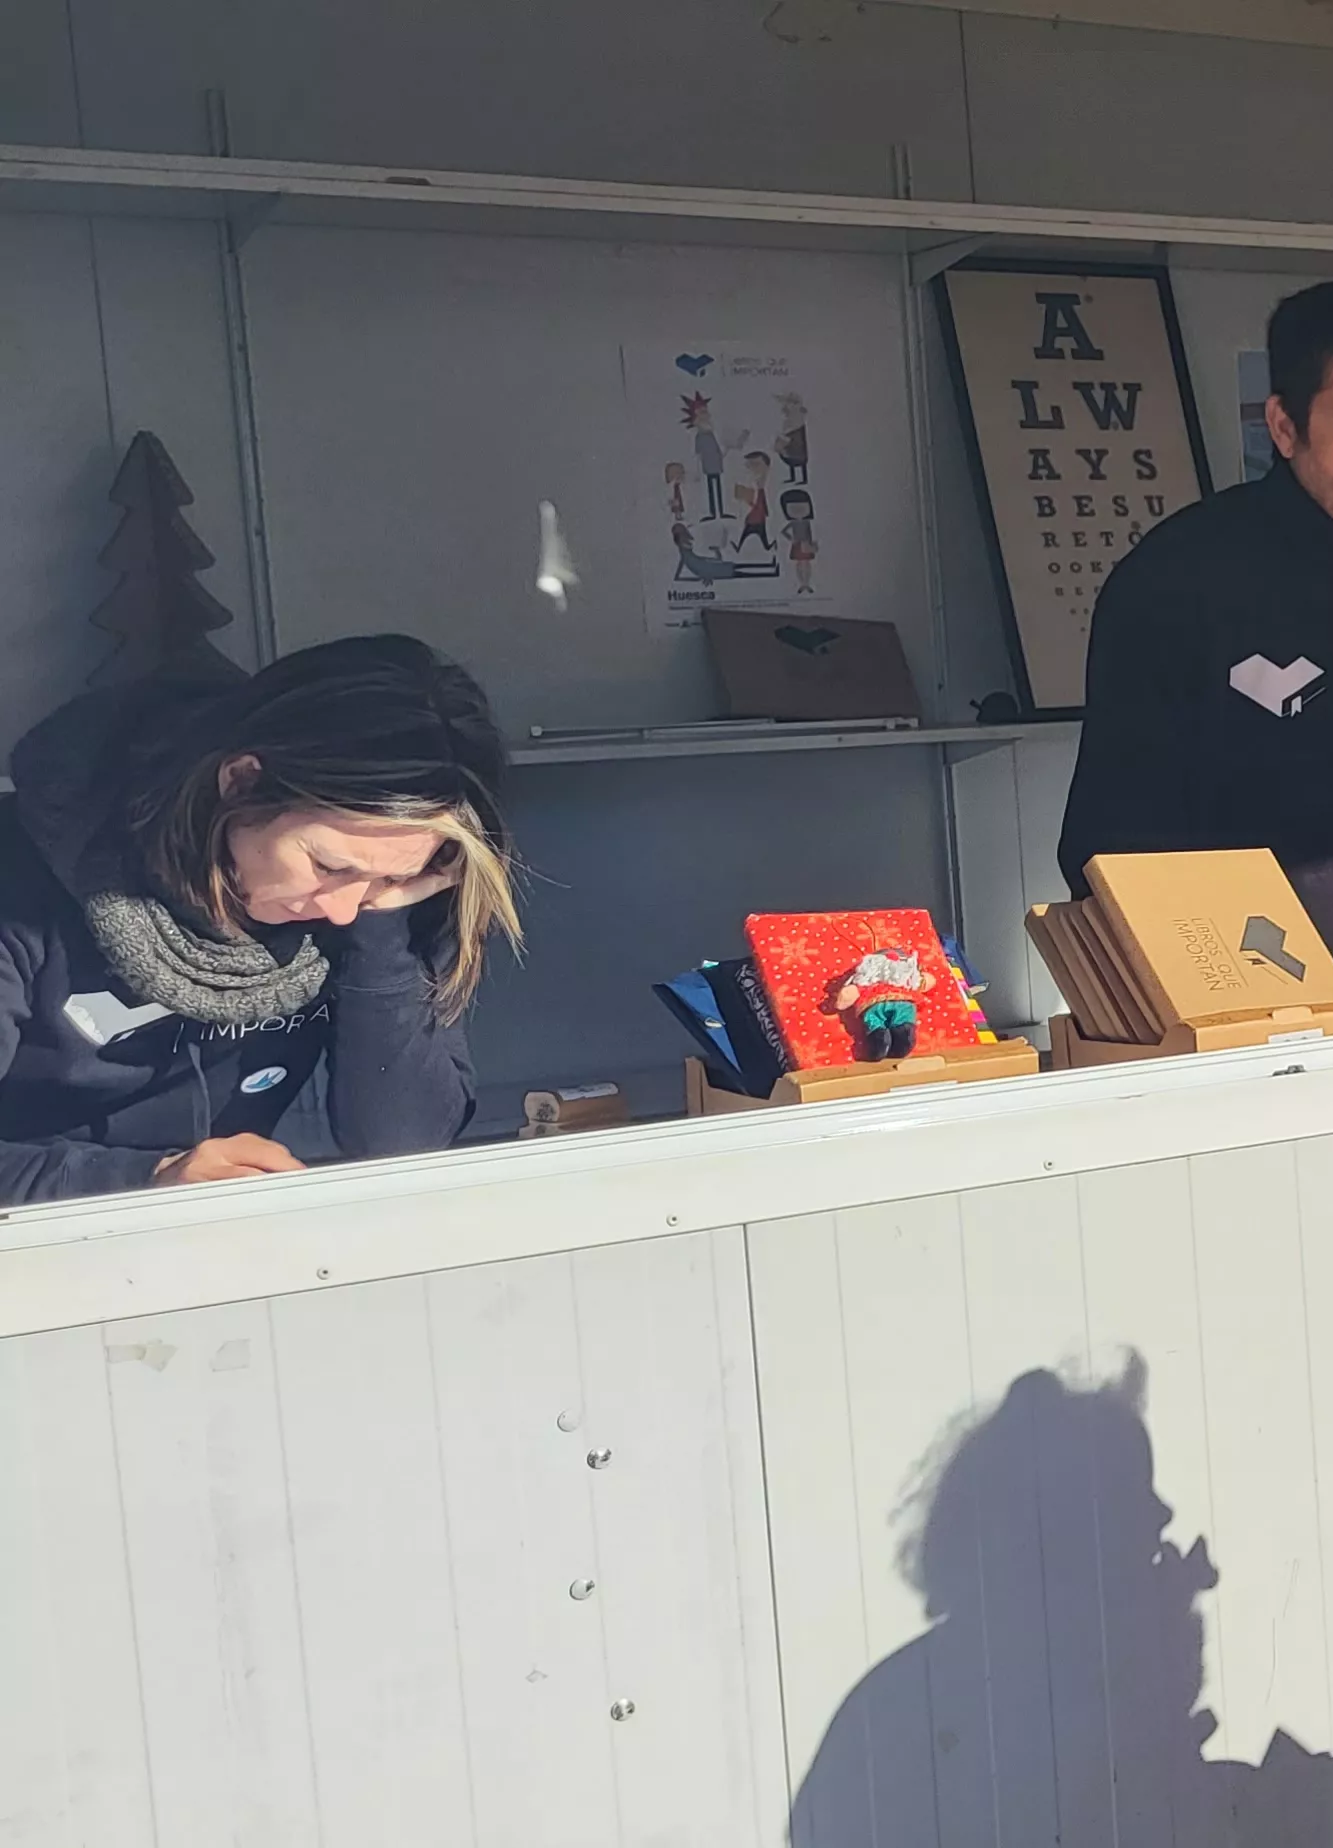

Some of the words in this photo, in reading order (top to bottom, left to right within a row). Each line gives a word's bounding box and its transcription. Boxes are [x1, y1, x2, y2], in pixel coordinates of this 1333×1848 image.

[1033, 291, 1105, 361] A
[667, 589, 716, 601] Huesca
[1172, 919, 1225, 991] IMPORTAN
[1191, 917, 1222, 956] LIBROS
[1217, 963, 1242, 989] QUE
